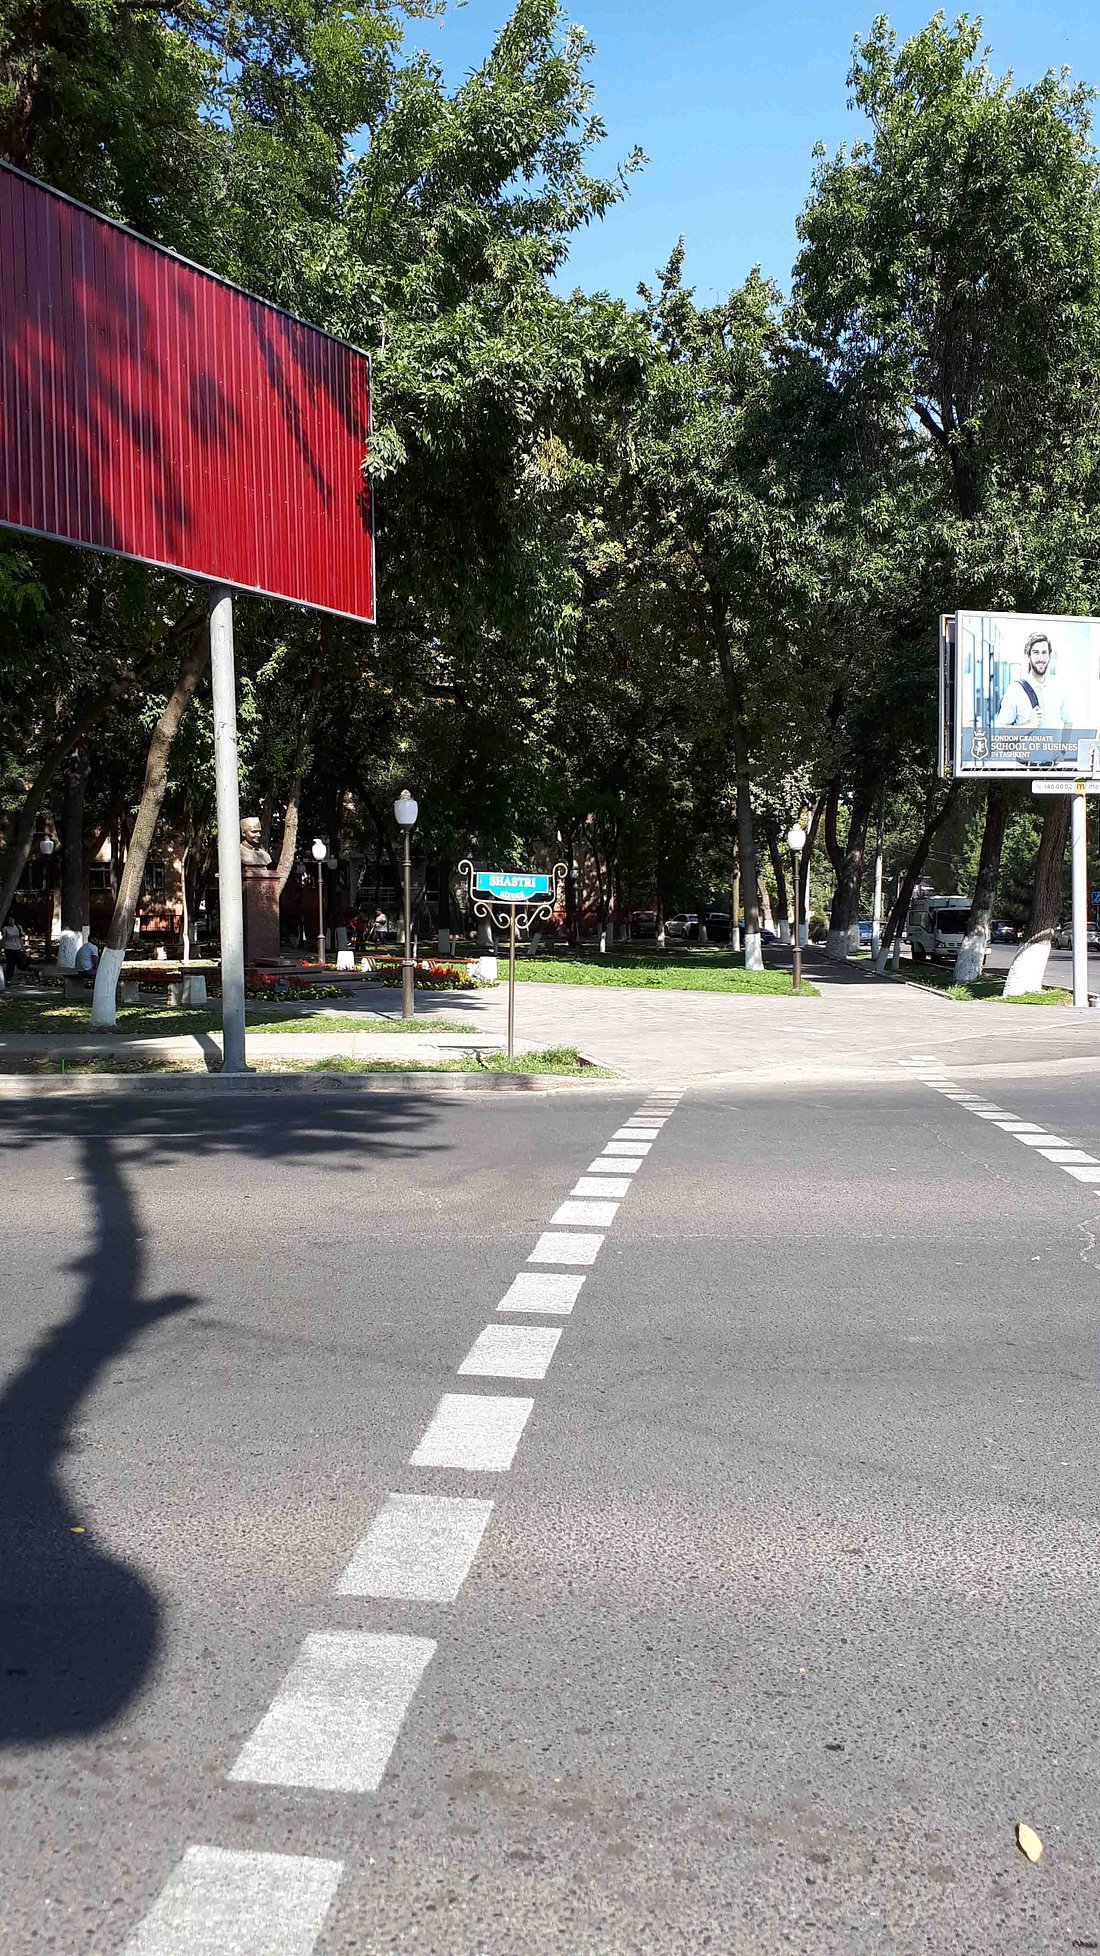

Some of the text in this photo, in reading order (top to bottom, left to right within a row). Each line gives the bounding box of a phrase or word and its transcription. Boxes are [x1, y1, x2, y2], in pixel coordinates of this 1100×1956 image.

[991, 742, 1078, 751] SCHOOL OF BUSINES
[489, 875, 537, 888] SHASTRI
